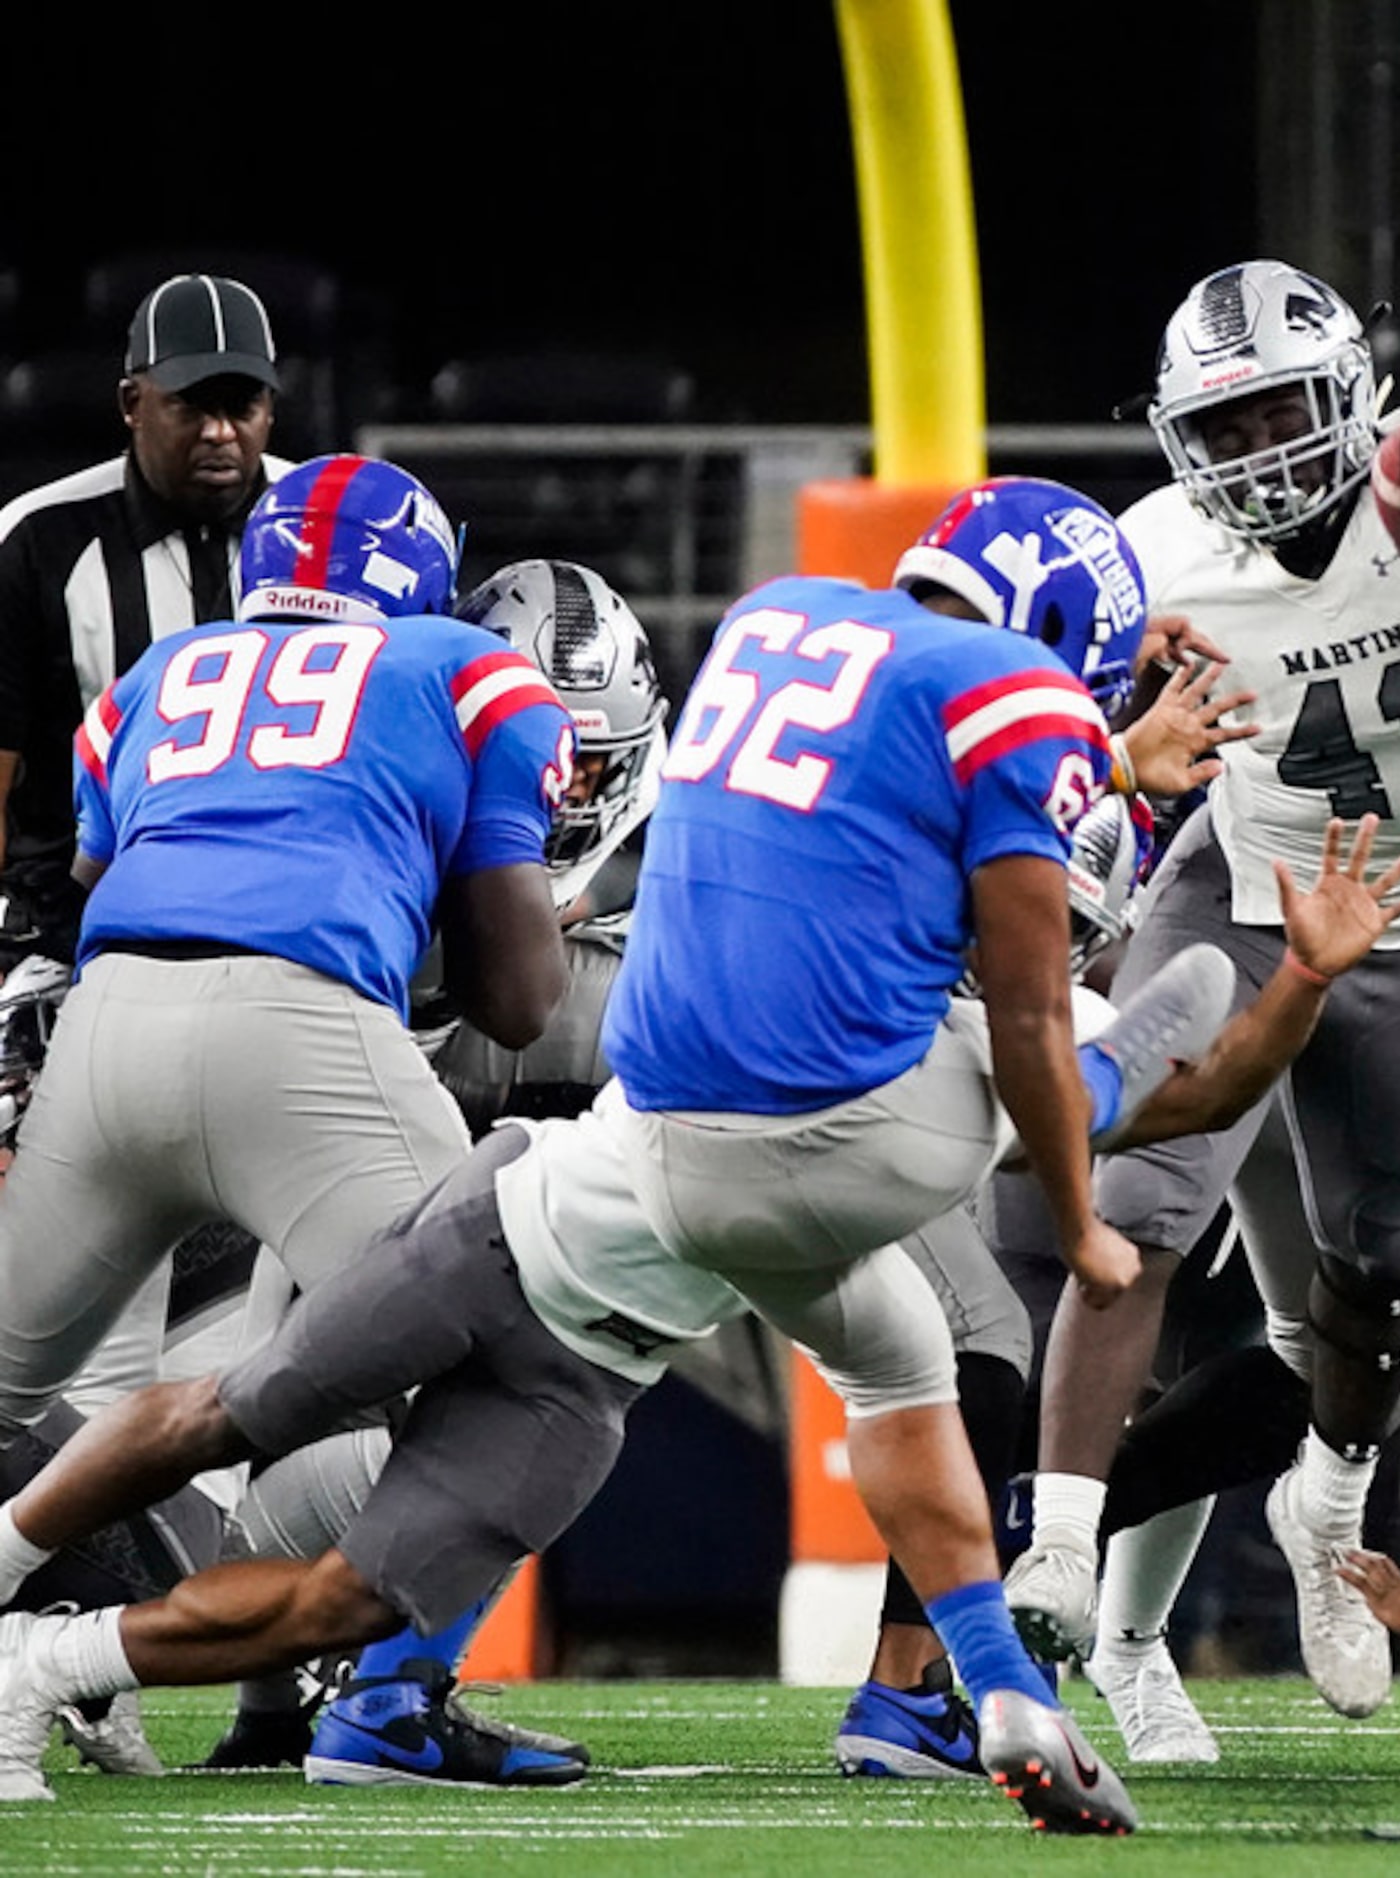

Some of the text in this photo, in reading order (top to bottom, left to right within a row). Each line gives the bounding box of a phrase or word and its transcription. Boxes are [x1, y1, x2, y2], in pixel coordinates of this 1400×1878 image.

[145, 622, 389, 785] 99
[659, 607, 896, 816] 62
[1043, 750, 1106, 836] 6
